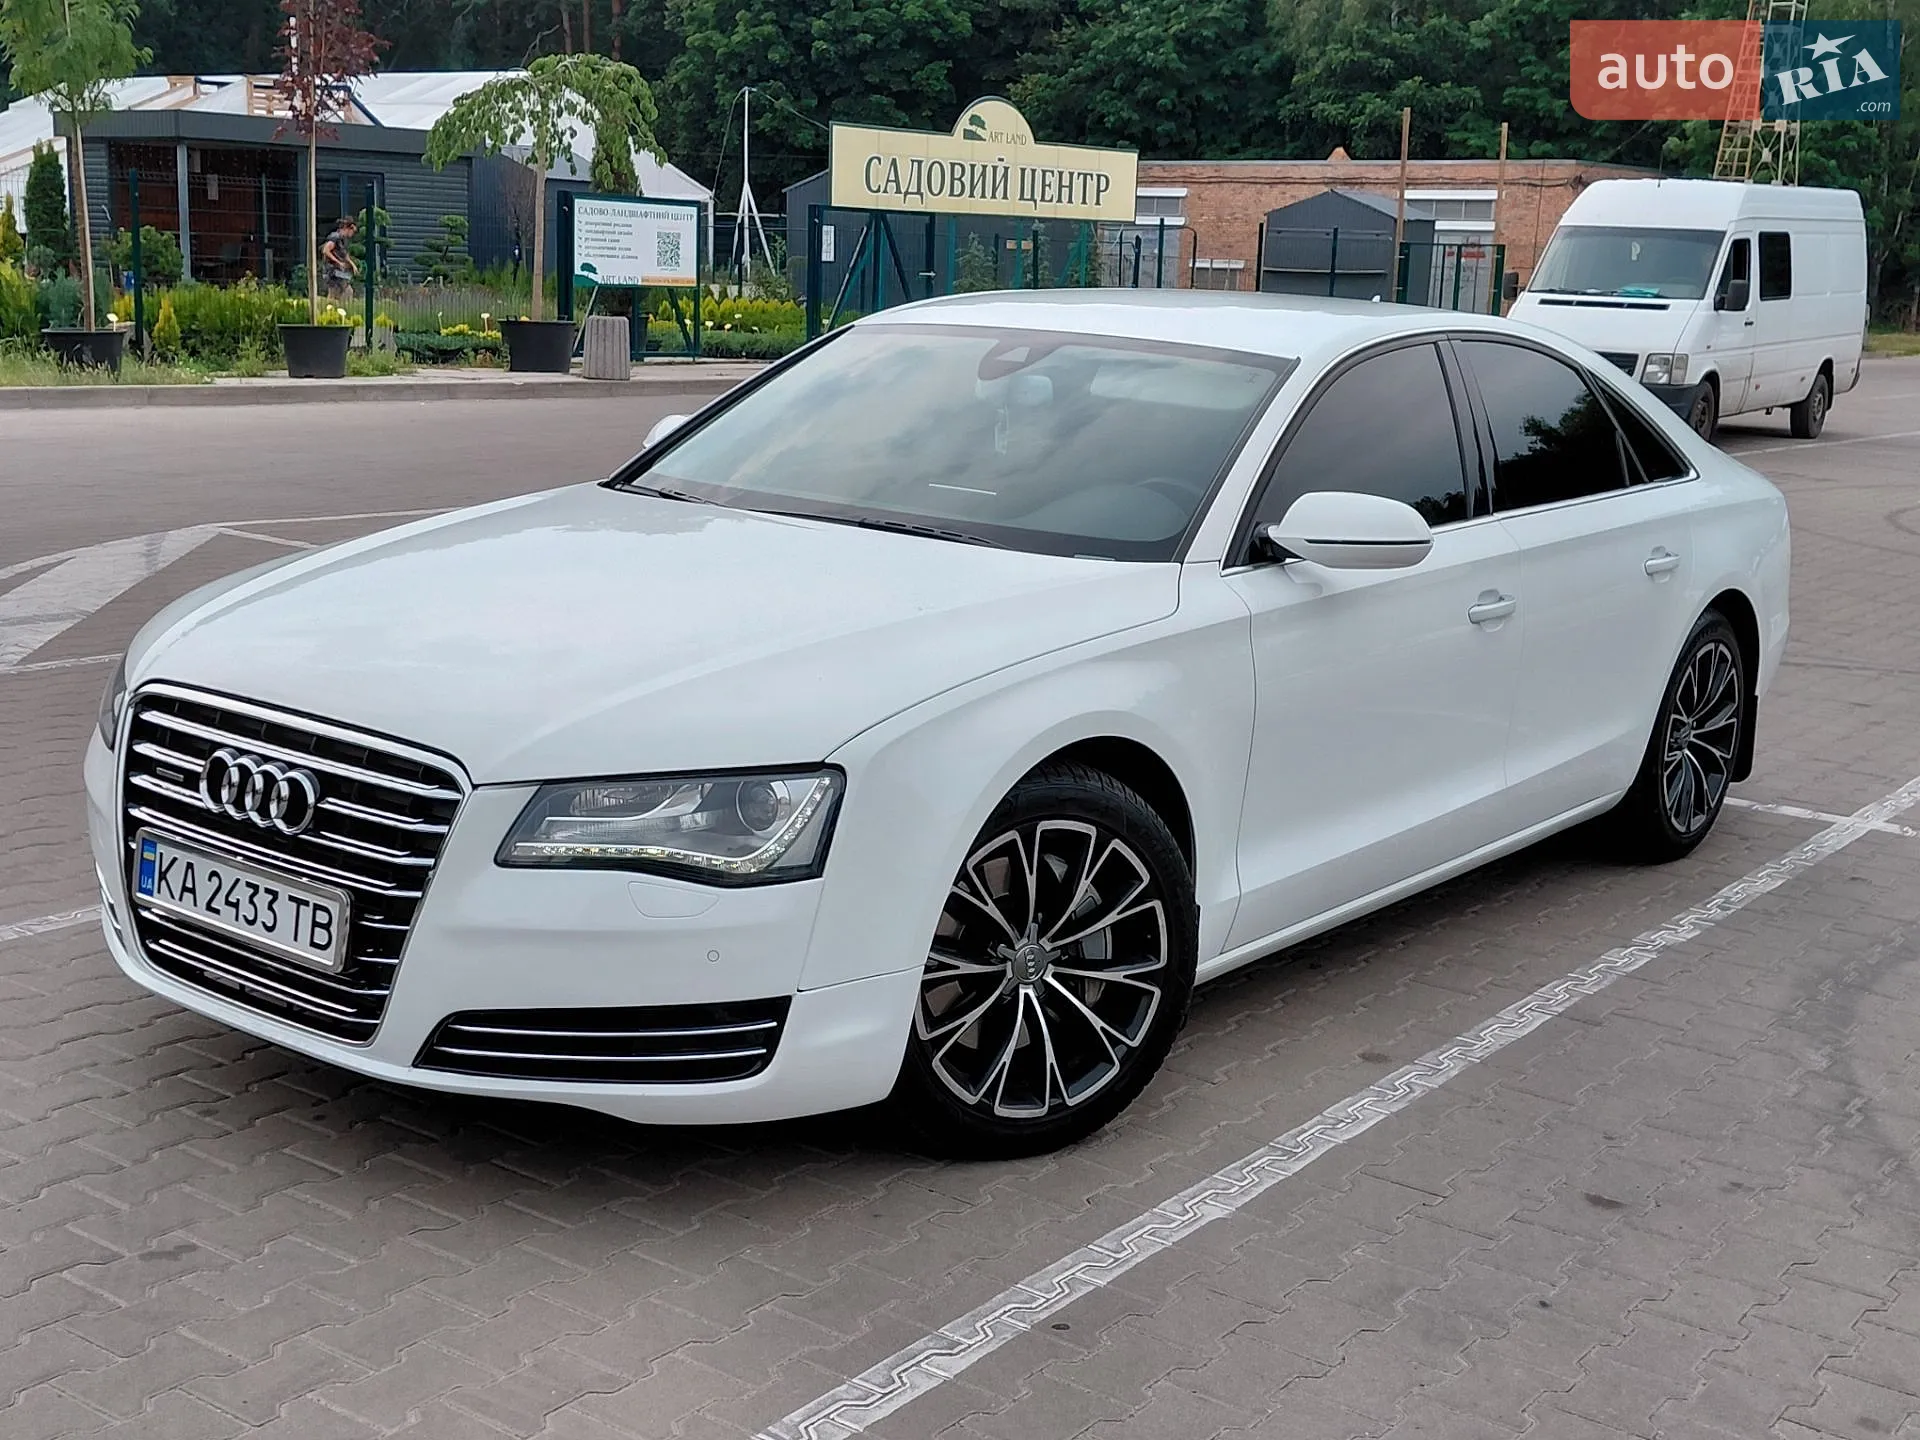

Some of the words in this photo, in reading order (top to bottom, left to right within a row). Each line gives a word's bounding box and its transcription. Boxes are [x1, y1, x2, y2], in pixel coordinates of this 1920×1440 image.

[988, 132, 1004, 144] ART
[1006, 132, 1027, 146] LAND
[864, 155, 1010, 205] САДОВИЙ
[1018, 166, 1111, 211] ЦЕНТР
[601, 275, 617, 284] ART
[141, 874, 153, 890] UA
[157, 851, 198, 907] KA
[205, 870, 279, 933] 2433
[288, 894, 333, 951] TB
